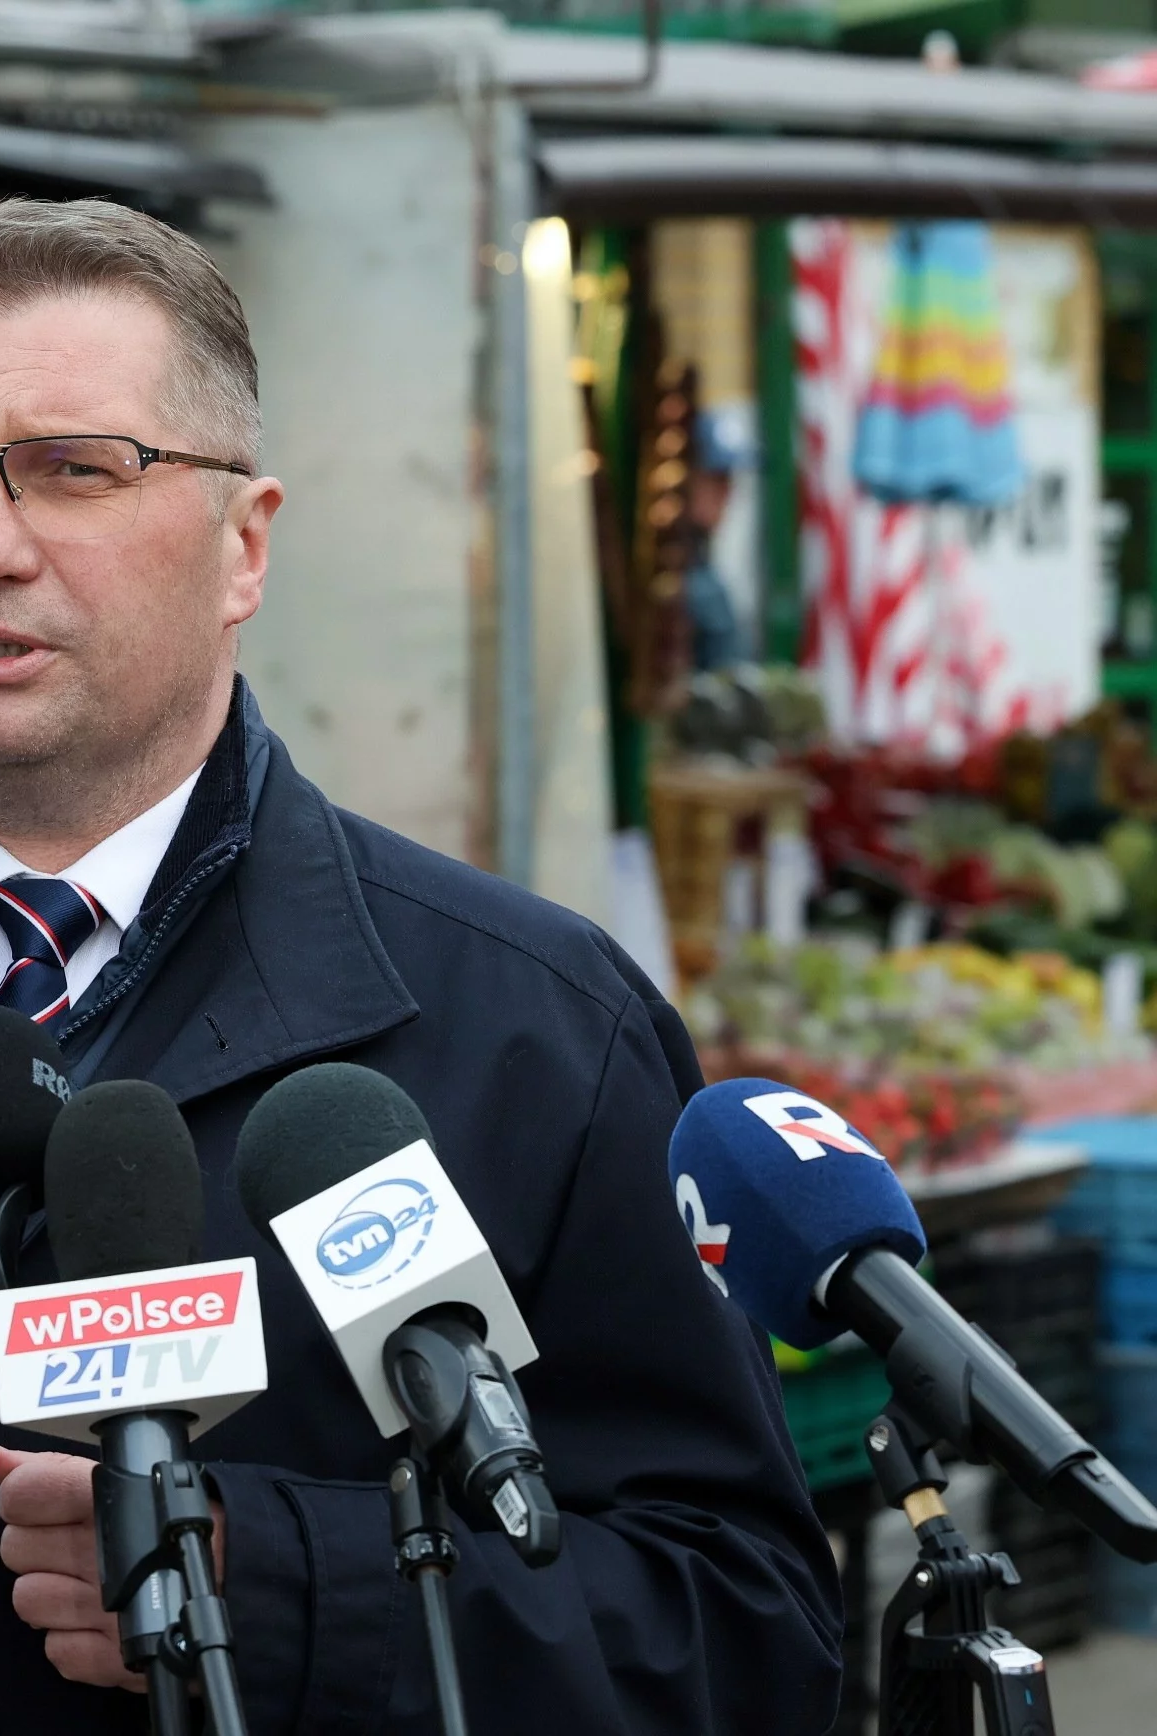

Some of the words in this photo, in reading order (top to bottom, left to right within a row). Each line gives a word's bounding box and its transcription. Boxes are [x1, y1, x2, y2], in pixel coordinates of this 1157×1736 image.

[743, 1091, 886, 1162] R
[323, 1223, 390, 1266] tvn
[394, 1196, 439, 1233] 24
[22, 1291, 225, 1346] wPolsce
[135, 1335, 223, 1389] TV
